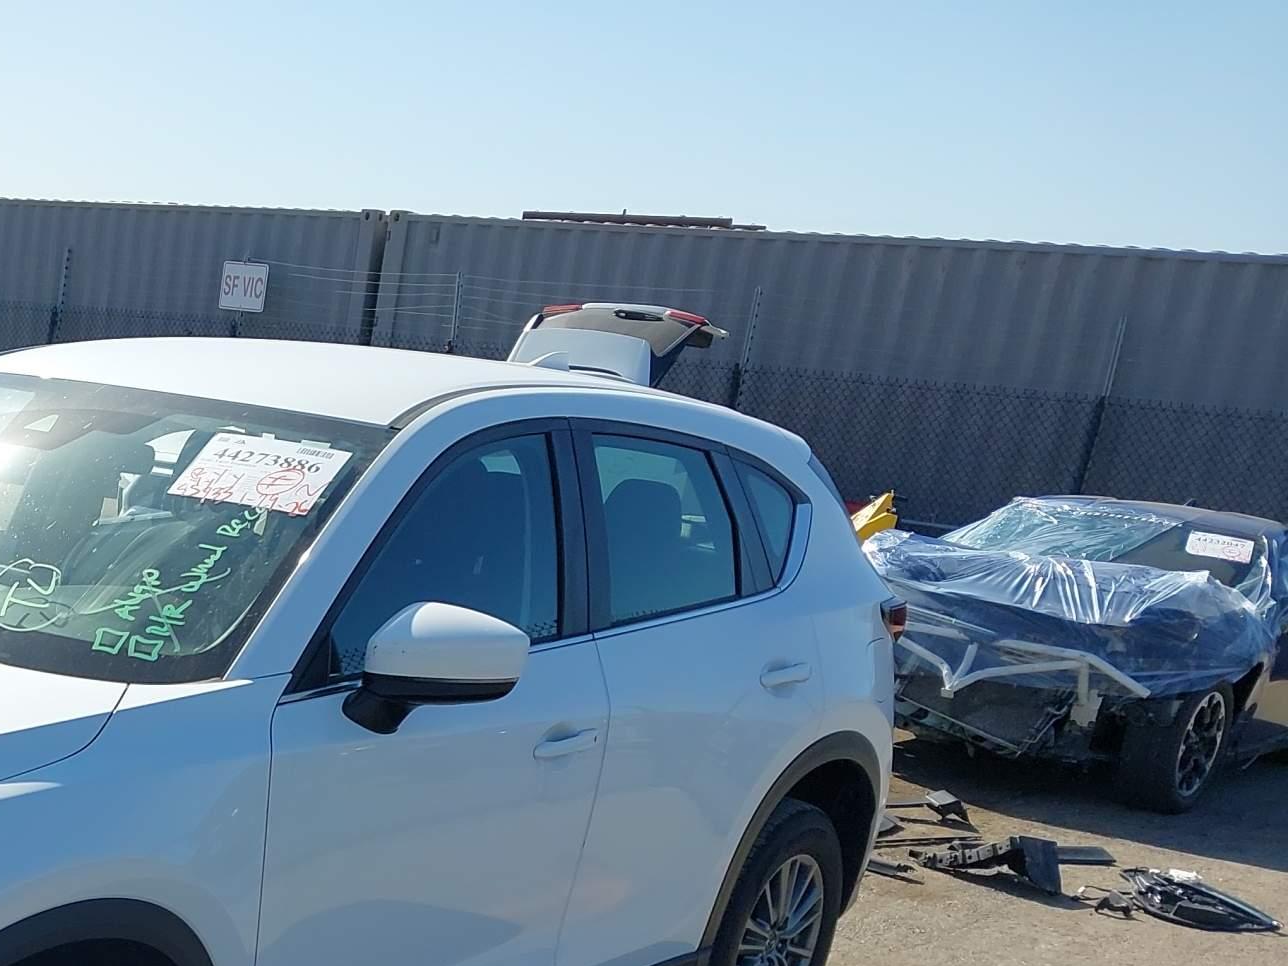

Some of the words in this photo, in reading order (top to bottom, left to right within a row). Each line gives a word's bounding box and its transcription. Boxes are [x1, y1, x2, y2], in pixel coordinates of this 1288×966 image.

[224, 274, 240, 296] SF
[243, 276, 263, 299] VIC
[212, 447, 323, 474] 44273886
